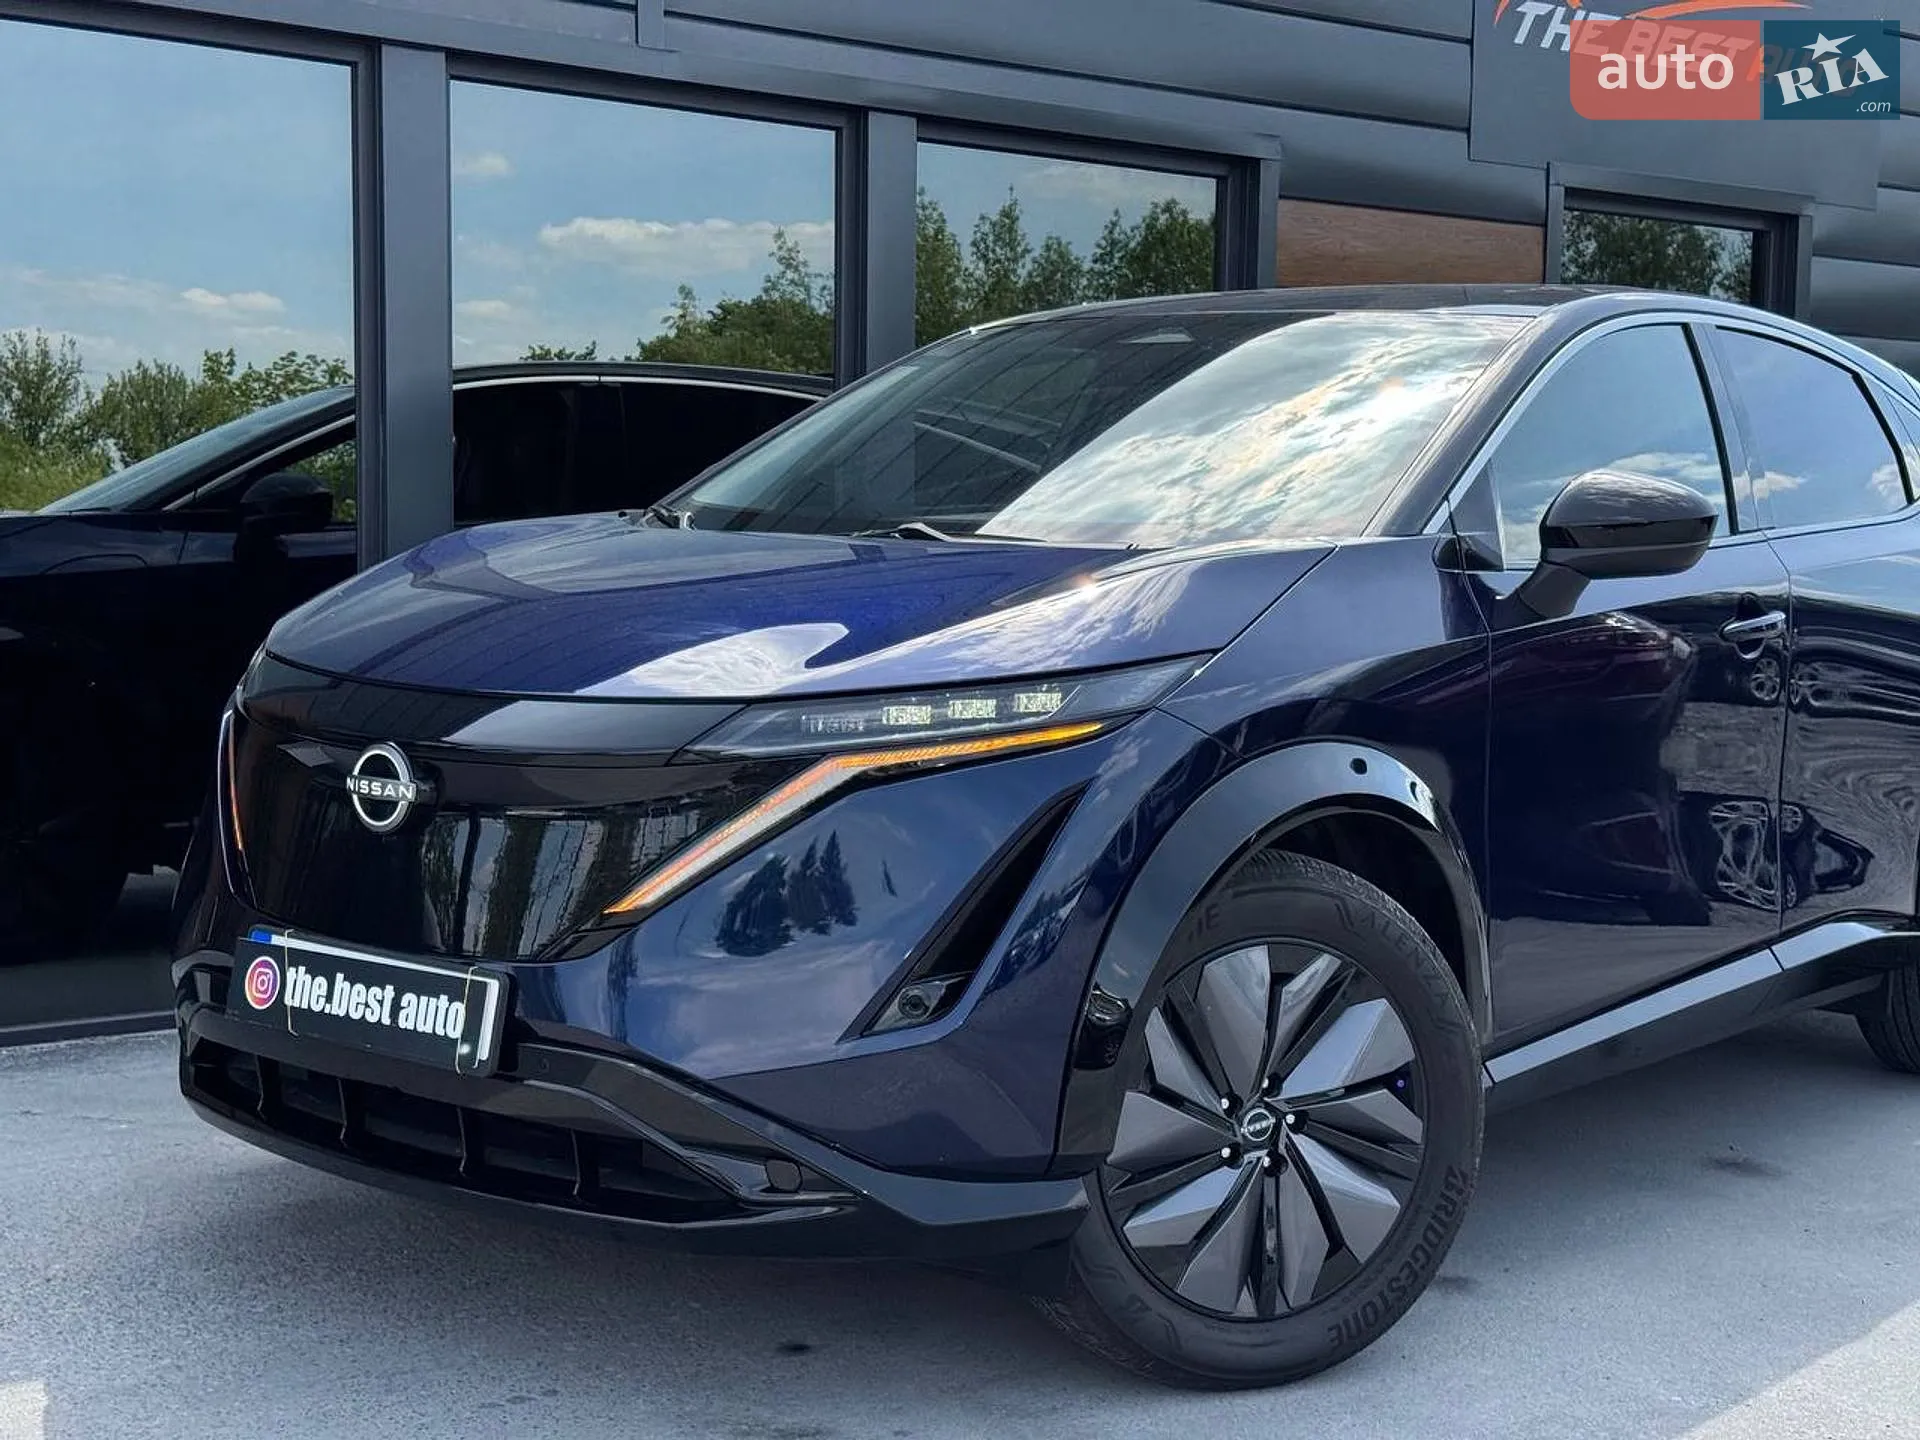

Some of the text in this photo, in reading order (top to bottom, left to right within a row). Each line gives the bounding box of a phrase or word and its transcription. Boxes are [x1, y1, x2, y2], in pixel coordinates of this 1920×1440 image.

[1513, 1, 1622, 57] THE
[1620, 19, 1755, 77] BEST
[346, 776, 414, 799] NISSAN
[284, 965, 466, 1039] the.best auto
[1326, 1164, 1472, 1350] BRIDGESTONE
